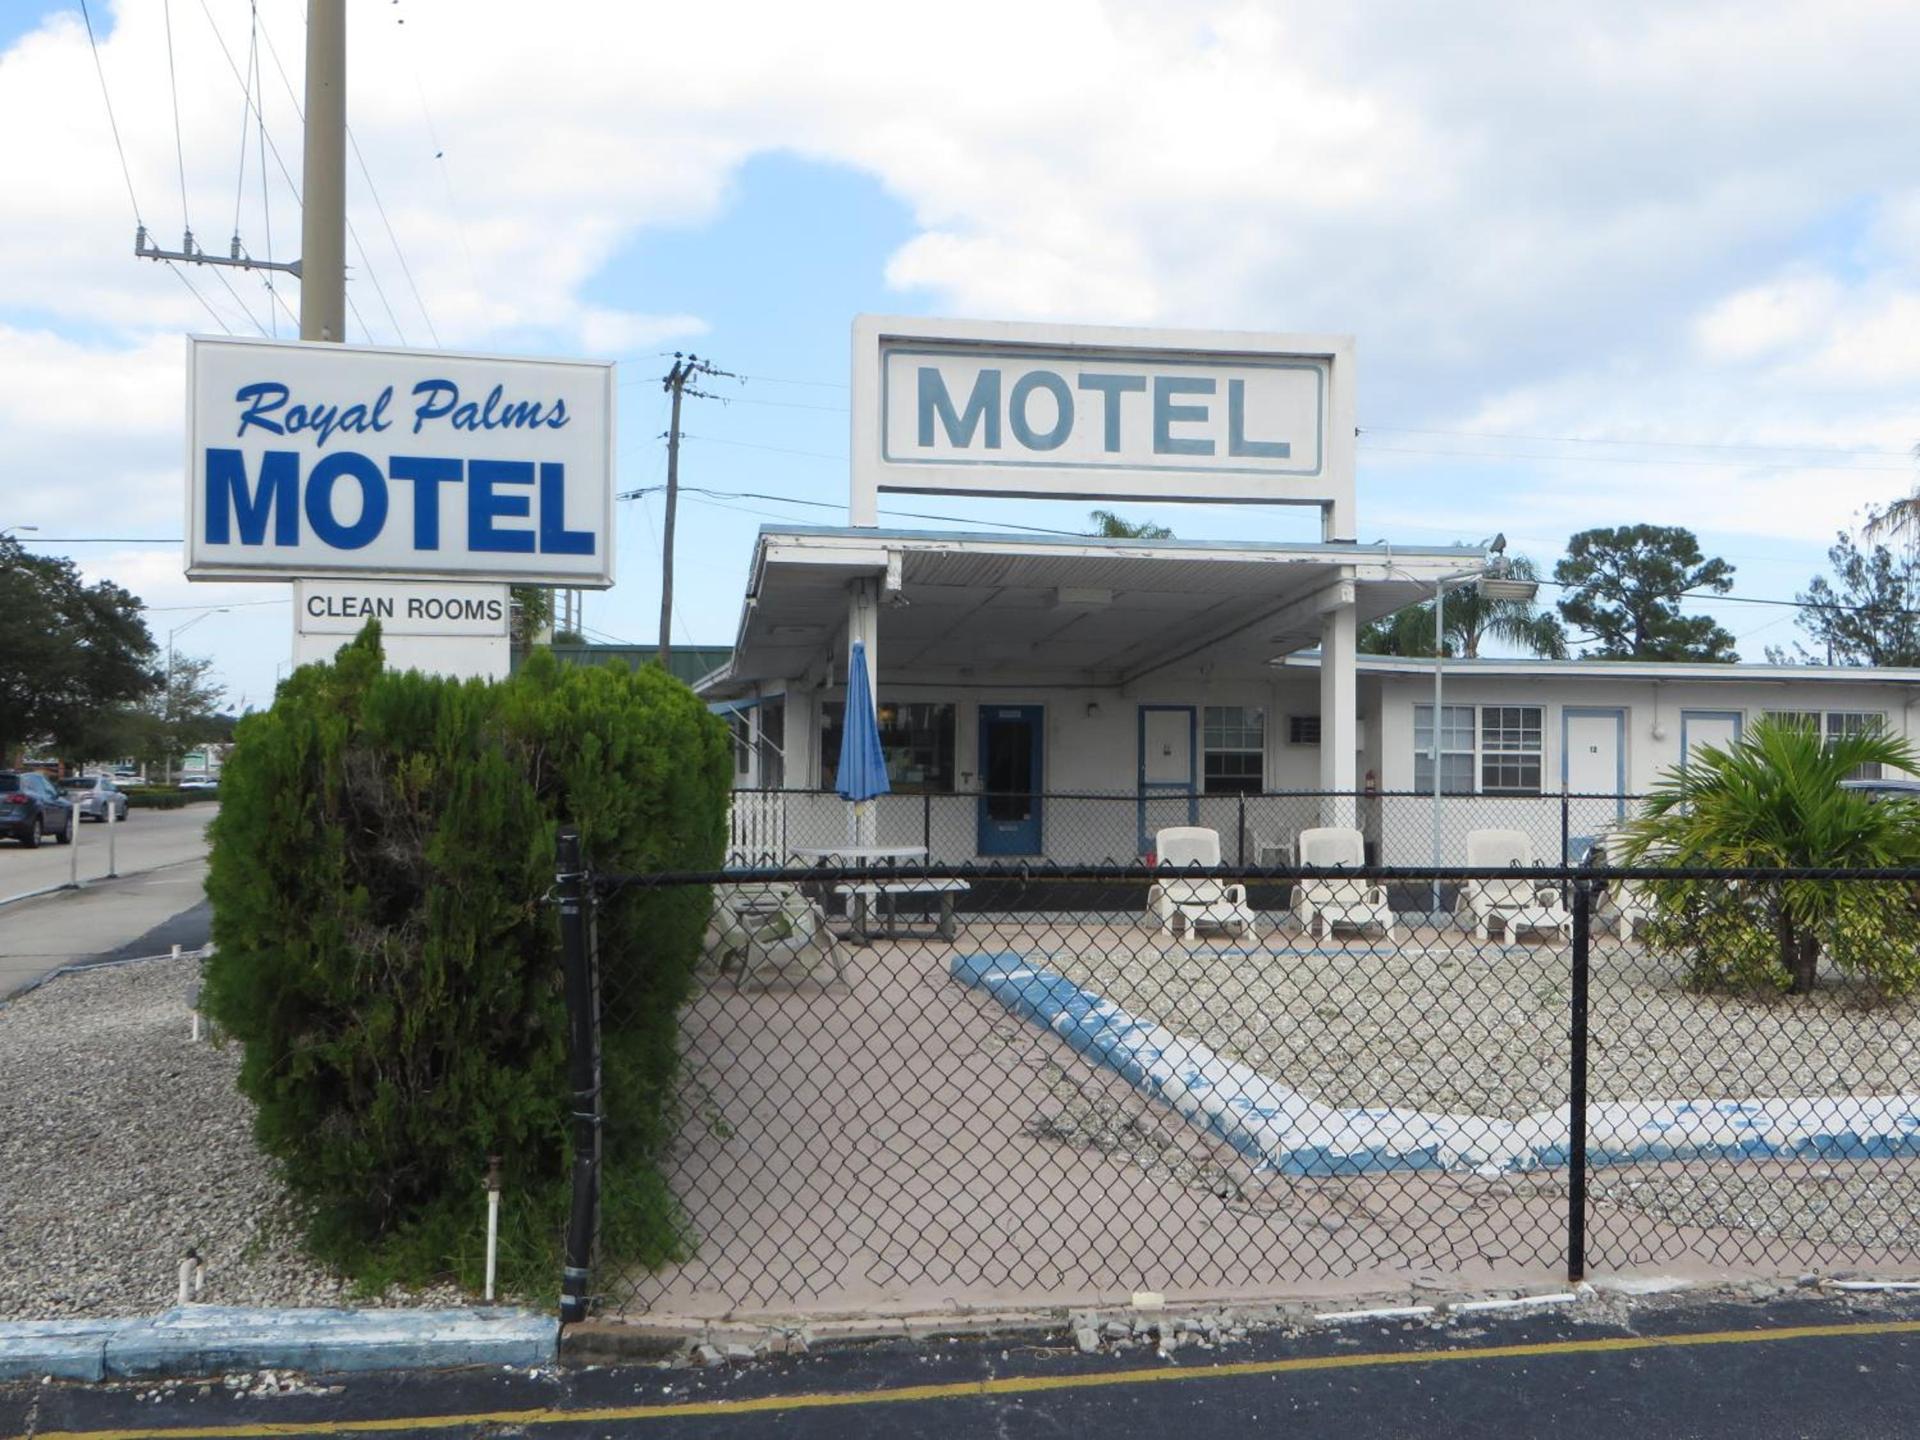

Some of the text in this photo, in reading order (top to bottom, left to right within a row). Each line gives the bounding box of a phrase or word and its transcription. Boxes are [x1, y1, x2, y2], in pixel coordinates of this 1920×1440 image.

[235, 378, 571, 447] Royal Palms
[917, 366, 1291, 459] MOTEL
[205, 447, 596, 556] MOTEL
[306, 596, 503, 621] CLEAN ROOMS
